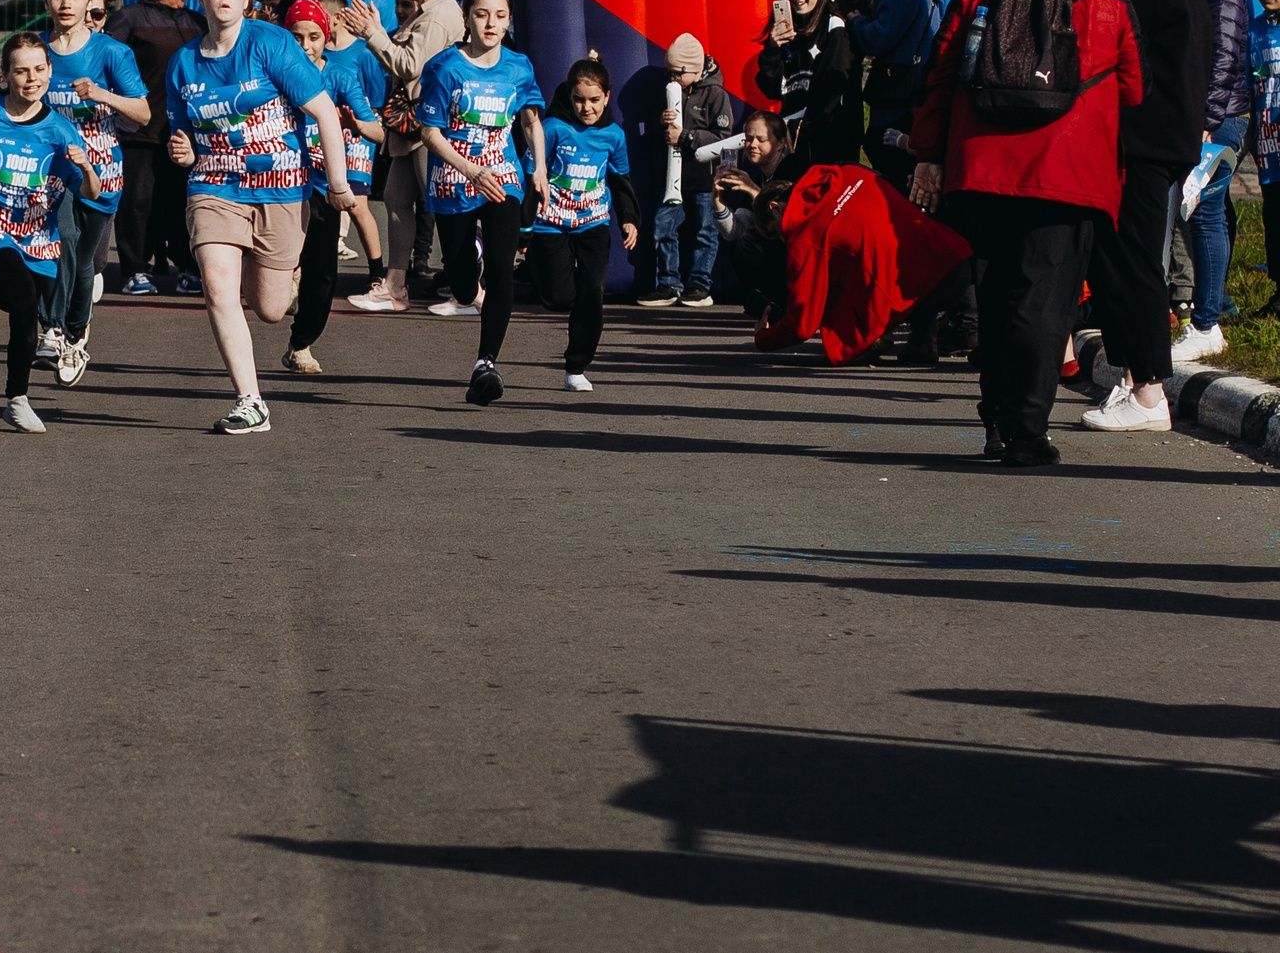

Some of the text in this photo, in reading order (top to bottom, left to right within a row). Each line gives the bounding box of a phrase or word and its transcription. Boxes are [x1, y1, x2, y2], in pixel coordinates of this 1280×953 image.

[47, 91, 80, 105] 10076
[473, 96, 507, 113] 10005
[199, 101, 233, 119] 10041
[346, 144, 371, 159] 2024
[6, 153, 39, 173] 10015
[271, 149, 302, 172] 2024
[99, 161, 123, 180] 2024
[566, 163, 598, 179] 10006
